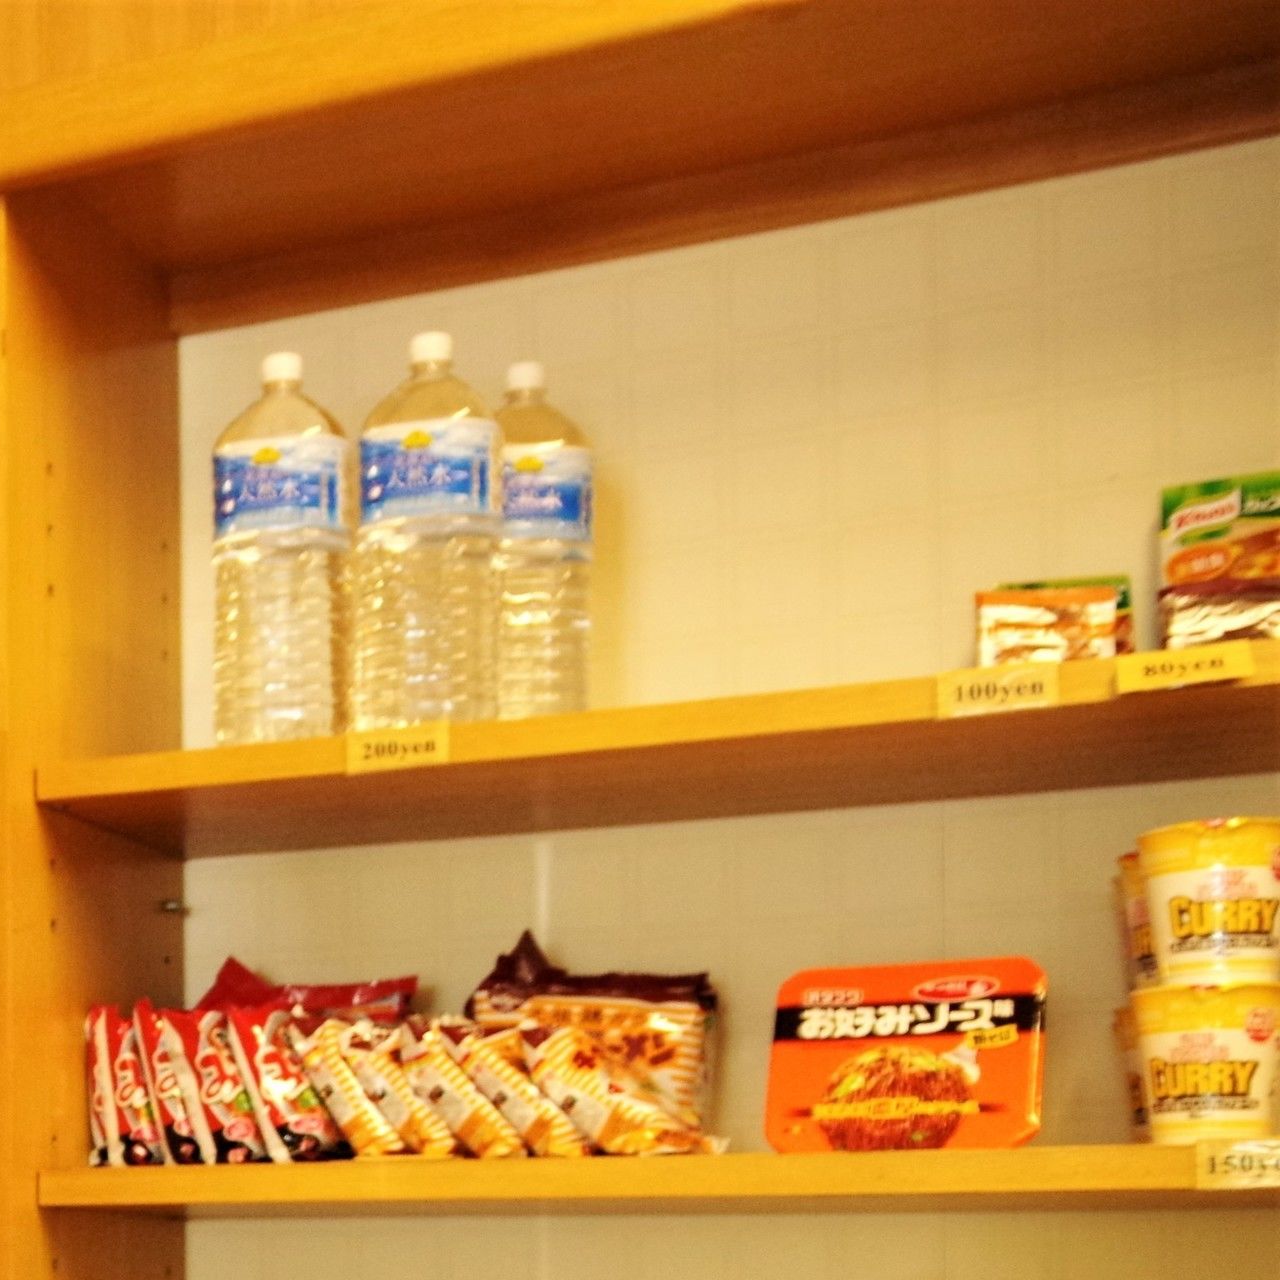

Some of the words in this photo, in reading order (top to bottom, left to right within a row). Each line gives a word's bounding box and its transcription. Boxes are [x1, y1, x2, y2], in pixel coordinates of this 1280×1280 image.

[1143, 658, 1224, 678] 80yen
[955, 681, 1045, 703] 100yen
[363, 737, 437, 760] 200yen
[1168, 896, 1280, 940] CURRY
[1151, 1058, 1259, 1099] CURRY
